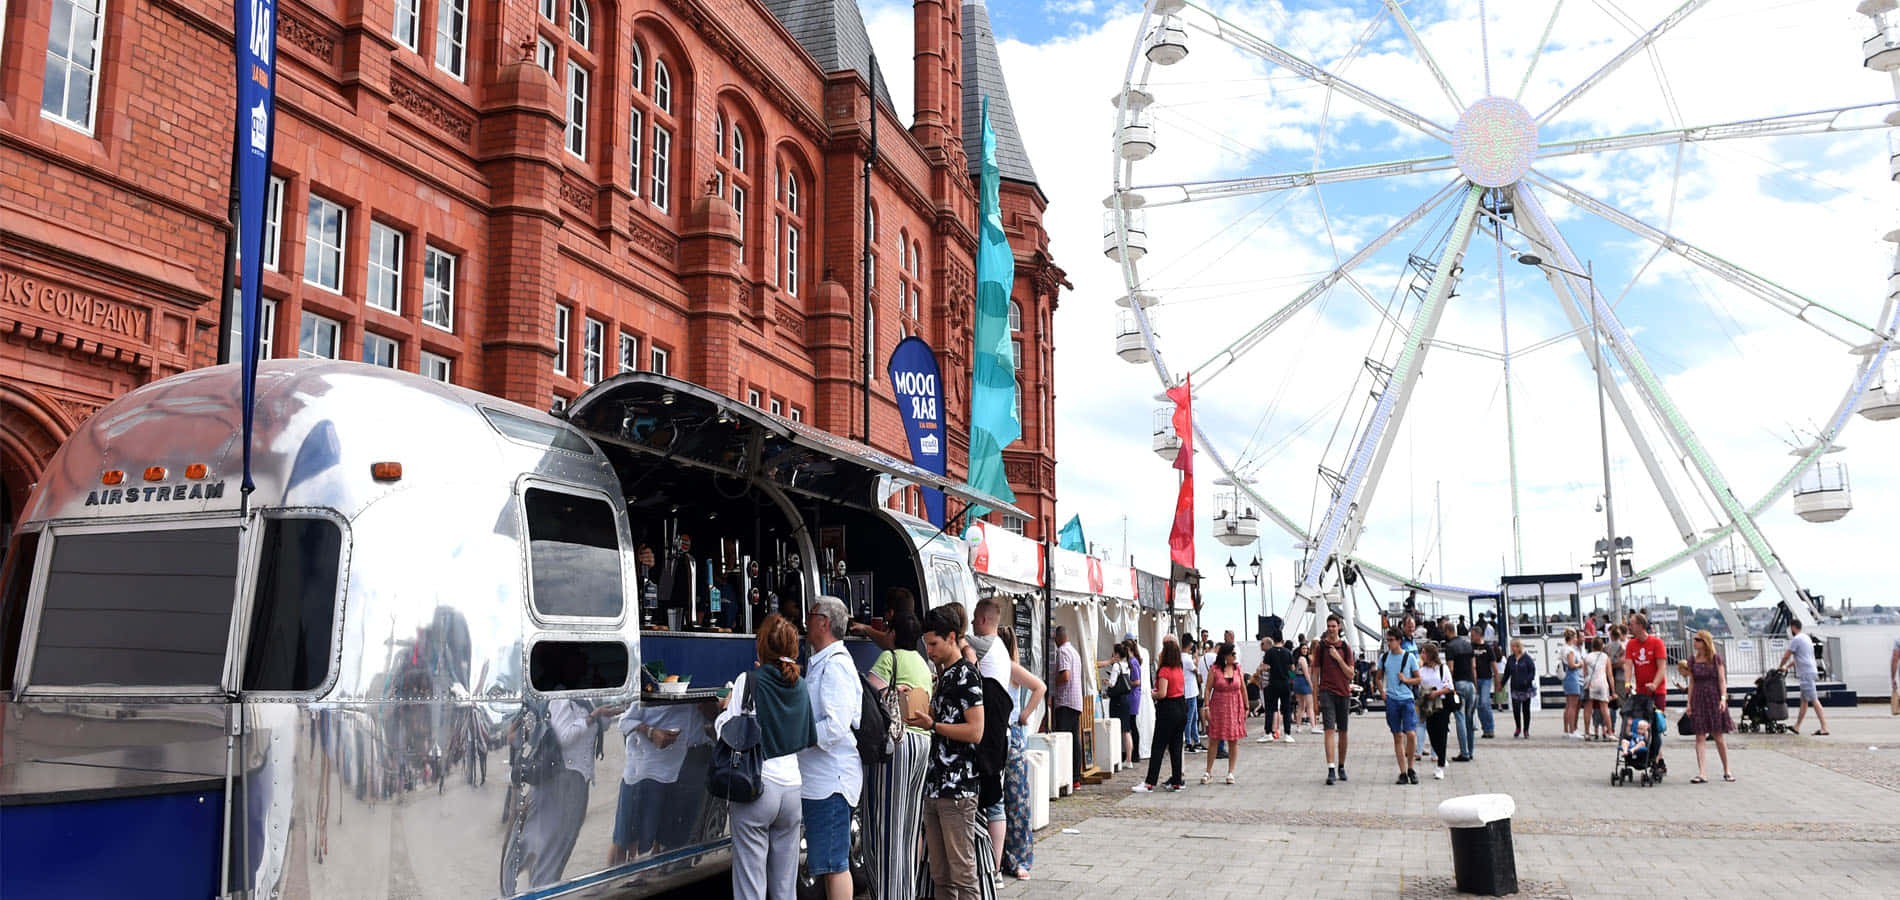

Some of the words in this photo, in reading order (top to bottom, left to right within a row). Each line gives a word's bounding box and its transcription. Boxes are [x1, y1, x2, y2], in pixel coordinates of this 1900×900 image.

[0, 271, 36, 308] KS
[38, 286, 147, 338] COMPANY
[85, 481, 226, 506] AIRSTREAM
